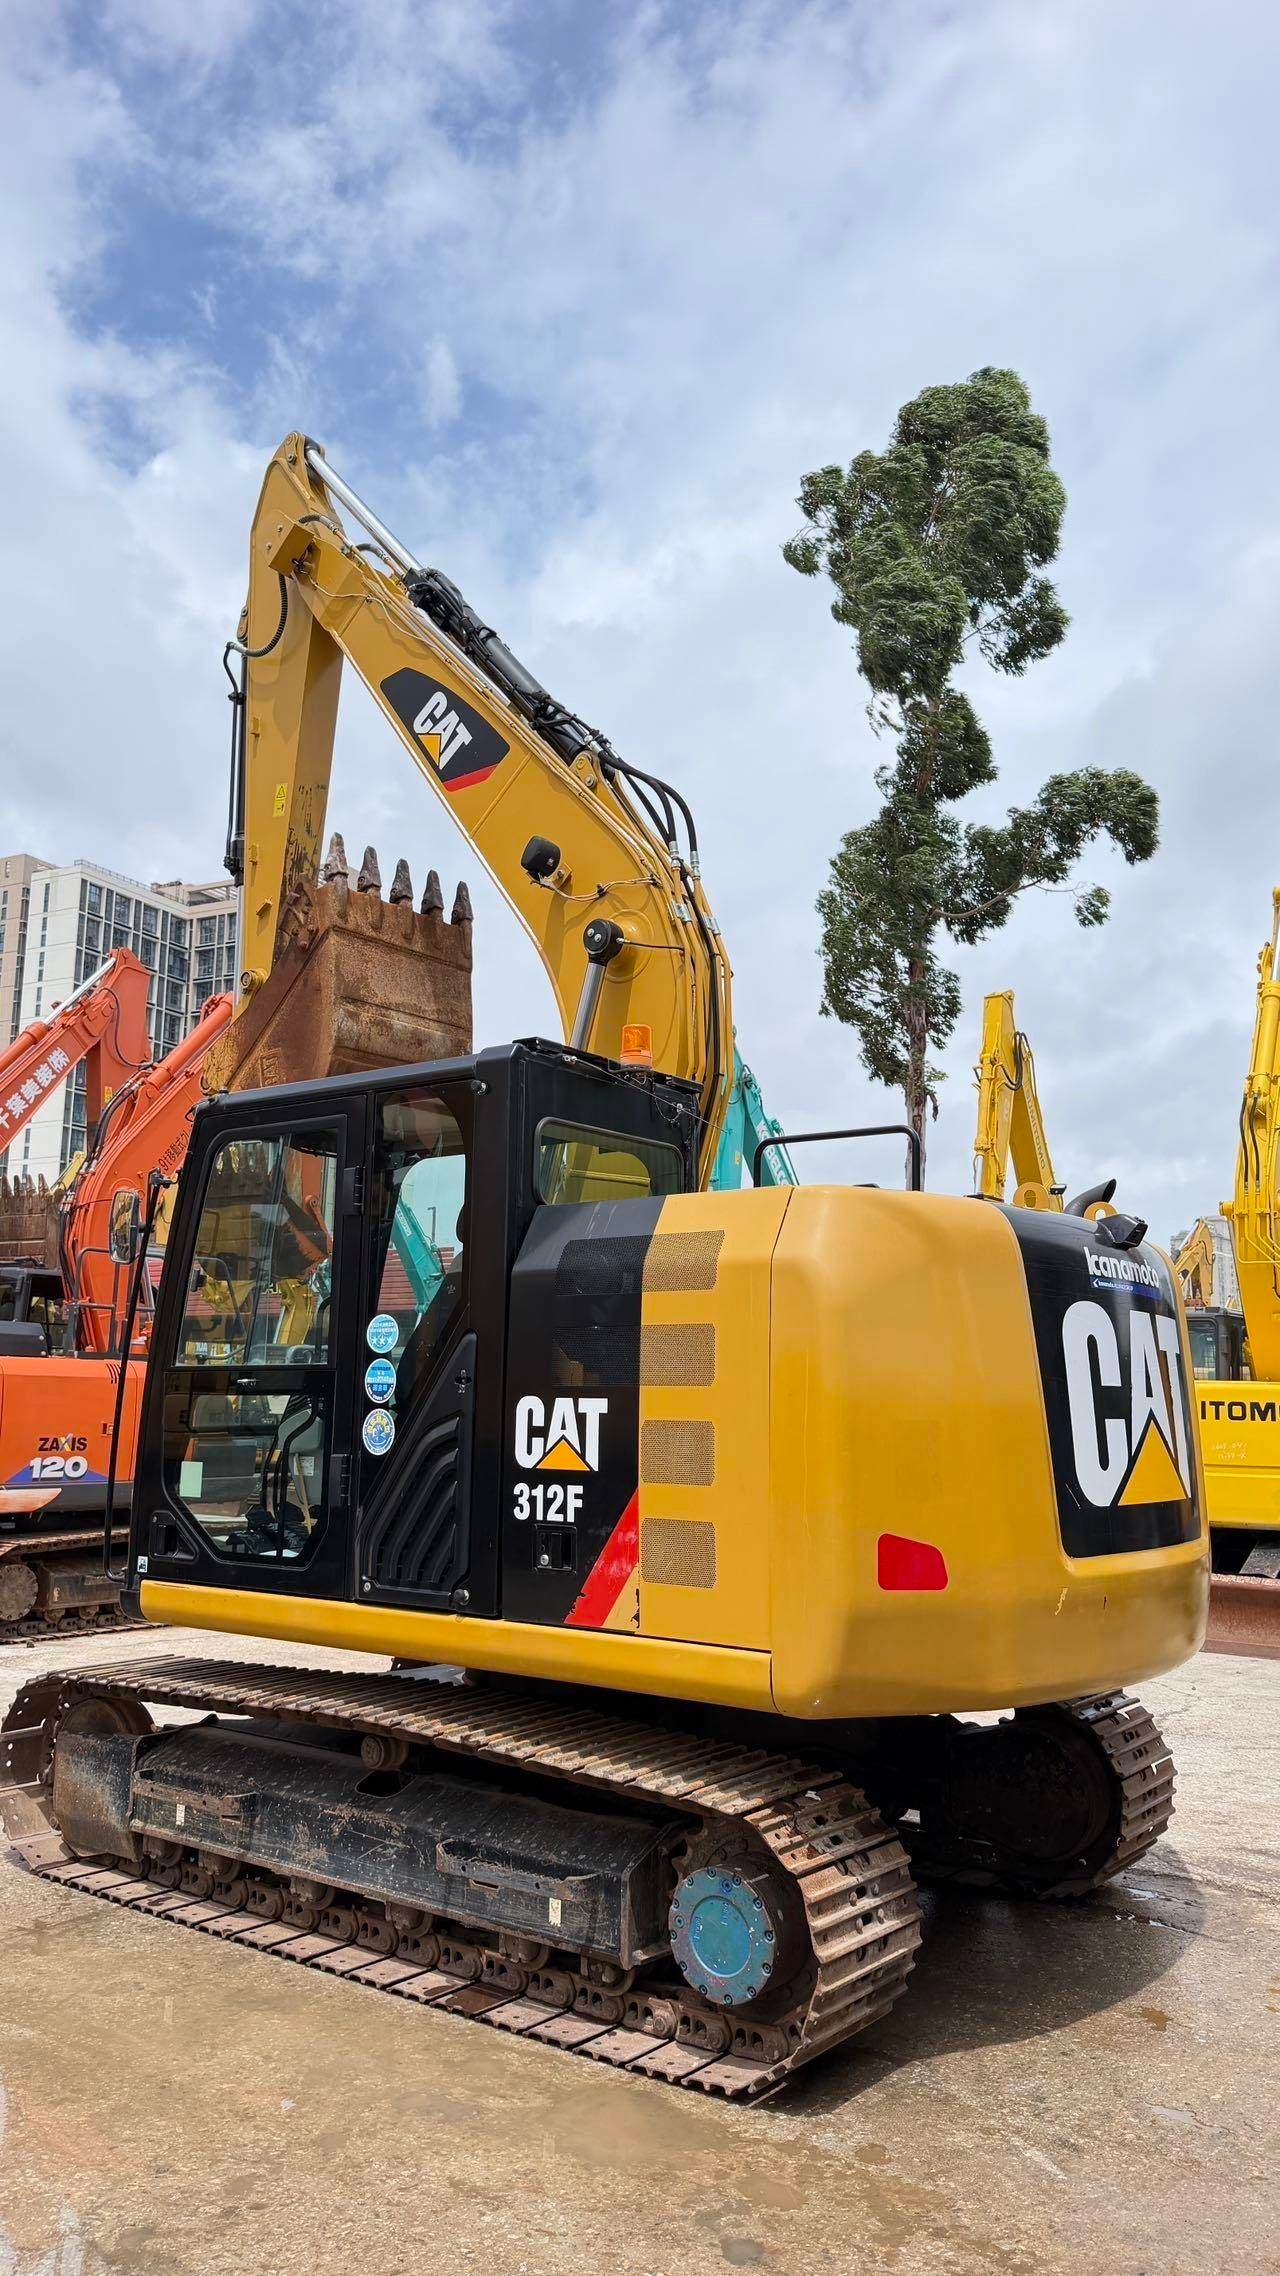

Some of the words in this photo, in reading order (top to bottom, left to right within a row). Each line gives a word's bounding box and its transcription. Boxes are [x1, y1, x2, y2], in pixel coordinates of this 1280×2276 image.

[413, 691, 473, 770] CAT
[1062, 1300, 1192, 1507] CAT
[1200, 1400, 1280, 1422] ITOM
[38, 1433, 88, 1452] ZAXIS
[515, 1395, 609, 1472] CAT
[29, 1455, 89, 1482] 120
[513, 1482, 584, 1523] 312F
